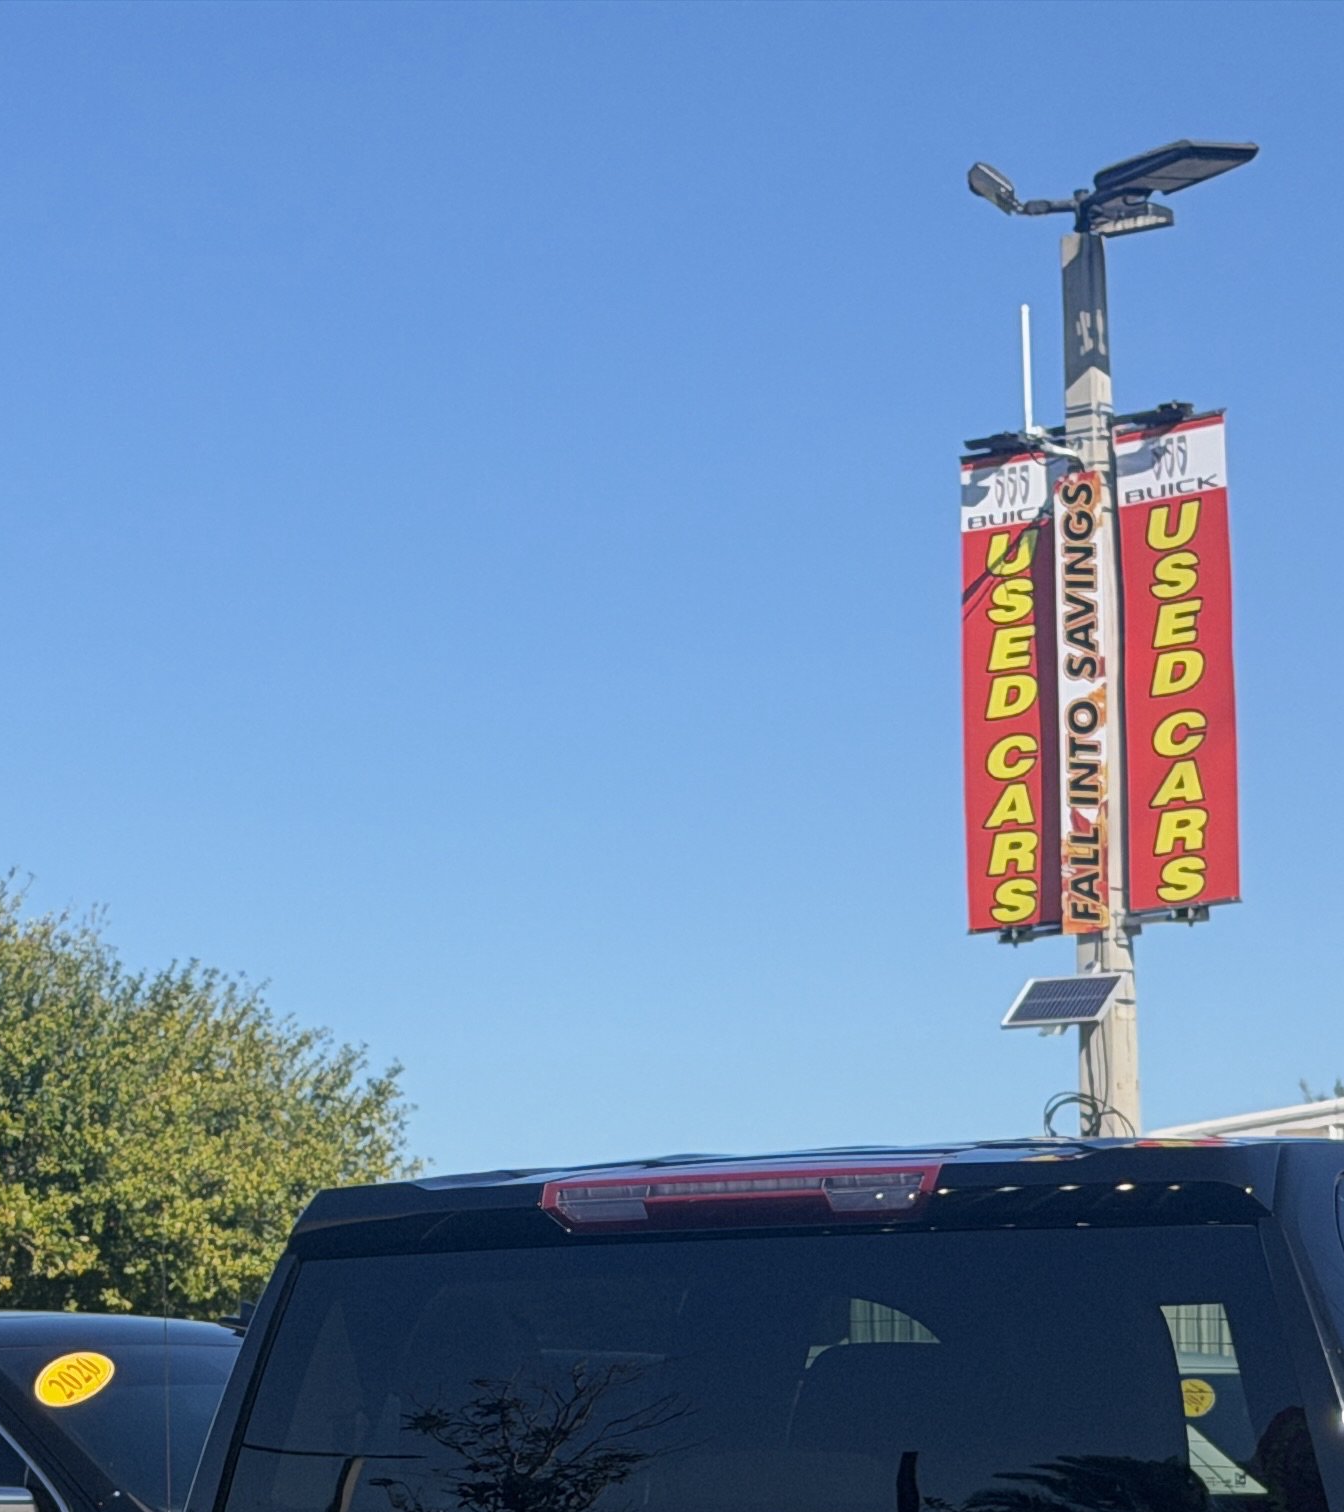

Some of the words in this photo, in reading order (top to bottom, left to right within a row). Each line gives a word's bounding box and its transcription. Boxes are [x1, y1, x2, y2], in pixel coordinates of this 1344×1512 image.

[1062, 480, 1098, 681] SAVINGS
[1124, 474, 1219, 504] BUICK
[985, 531, 1039, 721] USED
[1146, 499, 1205, 698] USED
[983, 733, 1039, 924] CARS
[1068, 699, 1101, 806] INTO
[1150, 710, 1208, 904] CARS
[1069, 825, 1101, 922] FALL
[49, 1357, 101, 1399] 2020
